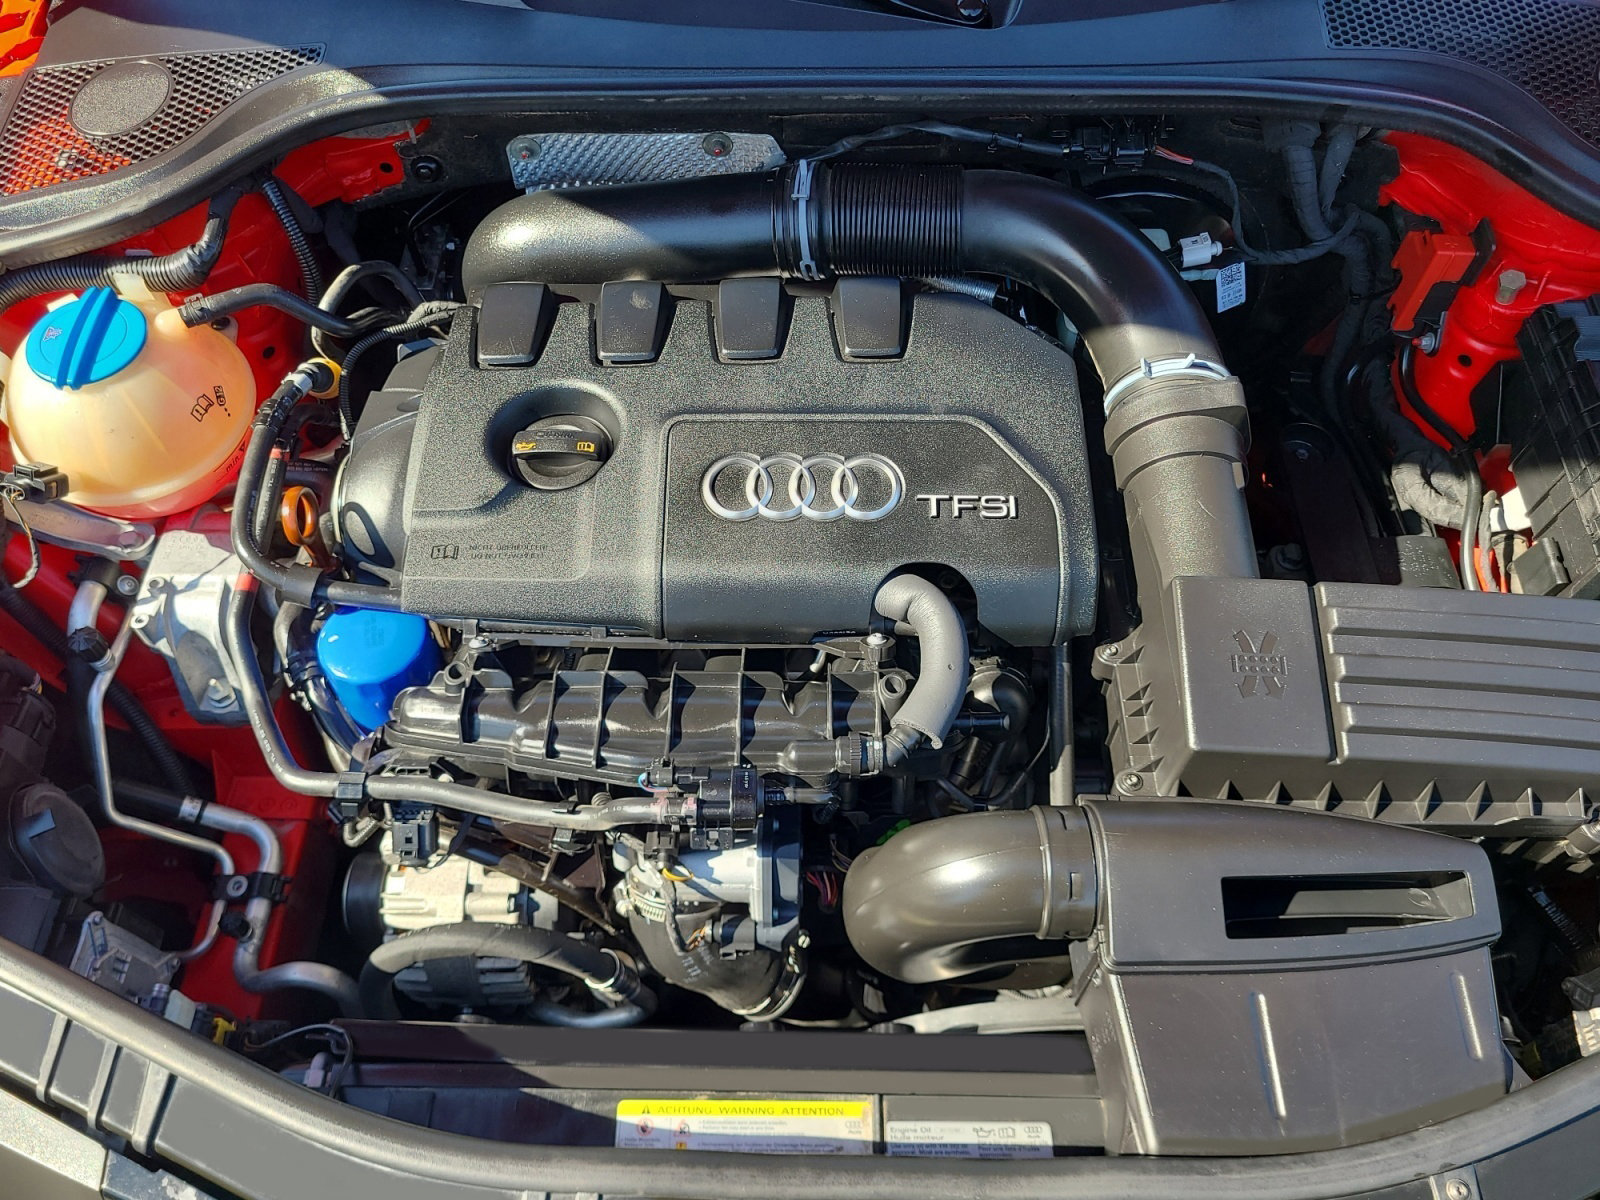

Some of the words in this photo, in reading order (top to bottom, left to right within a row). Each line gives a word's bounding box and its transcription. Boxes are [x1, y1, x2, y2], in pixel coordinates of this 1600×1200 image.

[225, 455, 240, 472] min
[915, 494, 1018, 519] TFSI
[657, 1105, 712, 1115] ACHTUNG
[719, 1106, 775, 1115] WARNING
[781, 1107, 845, 1116] ATTENTION
[890, 1127, 918, 1136] Engine
[920, 1126, 931, 1134] Oil
